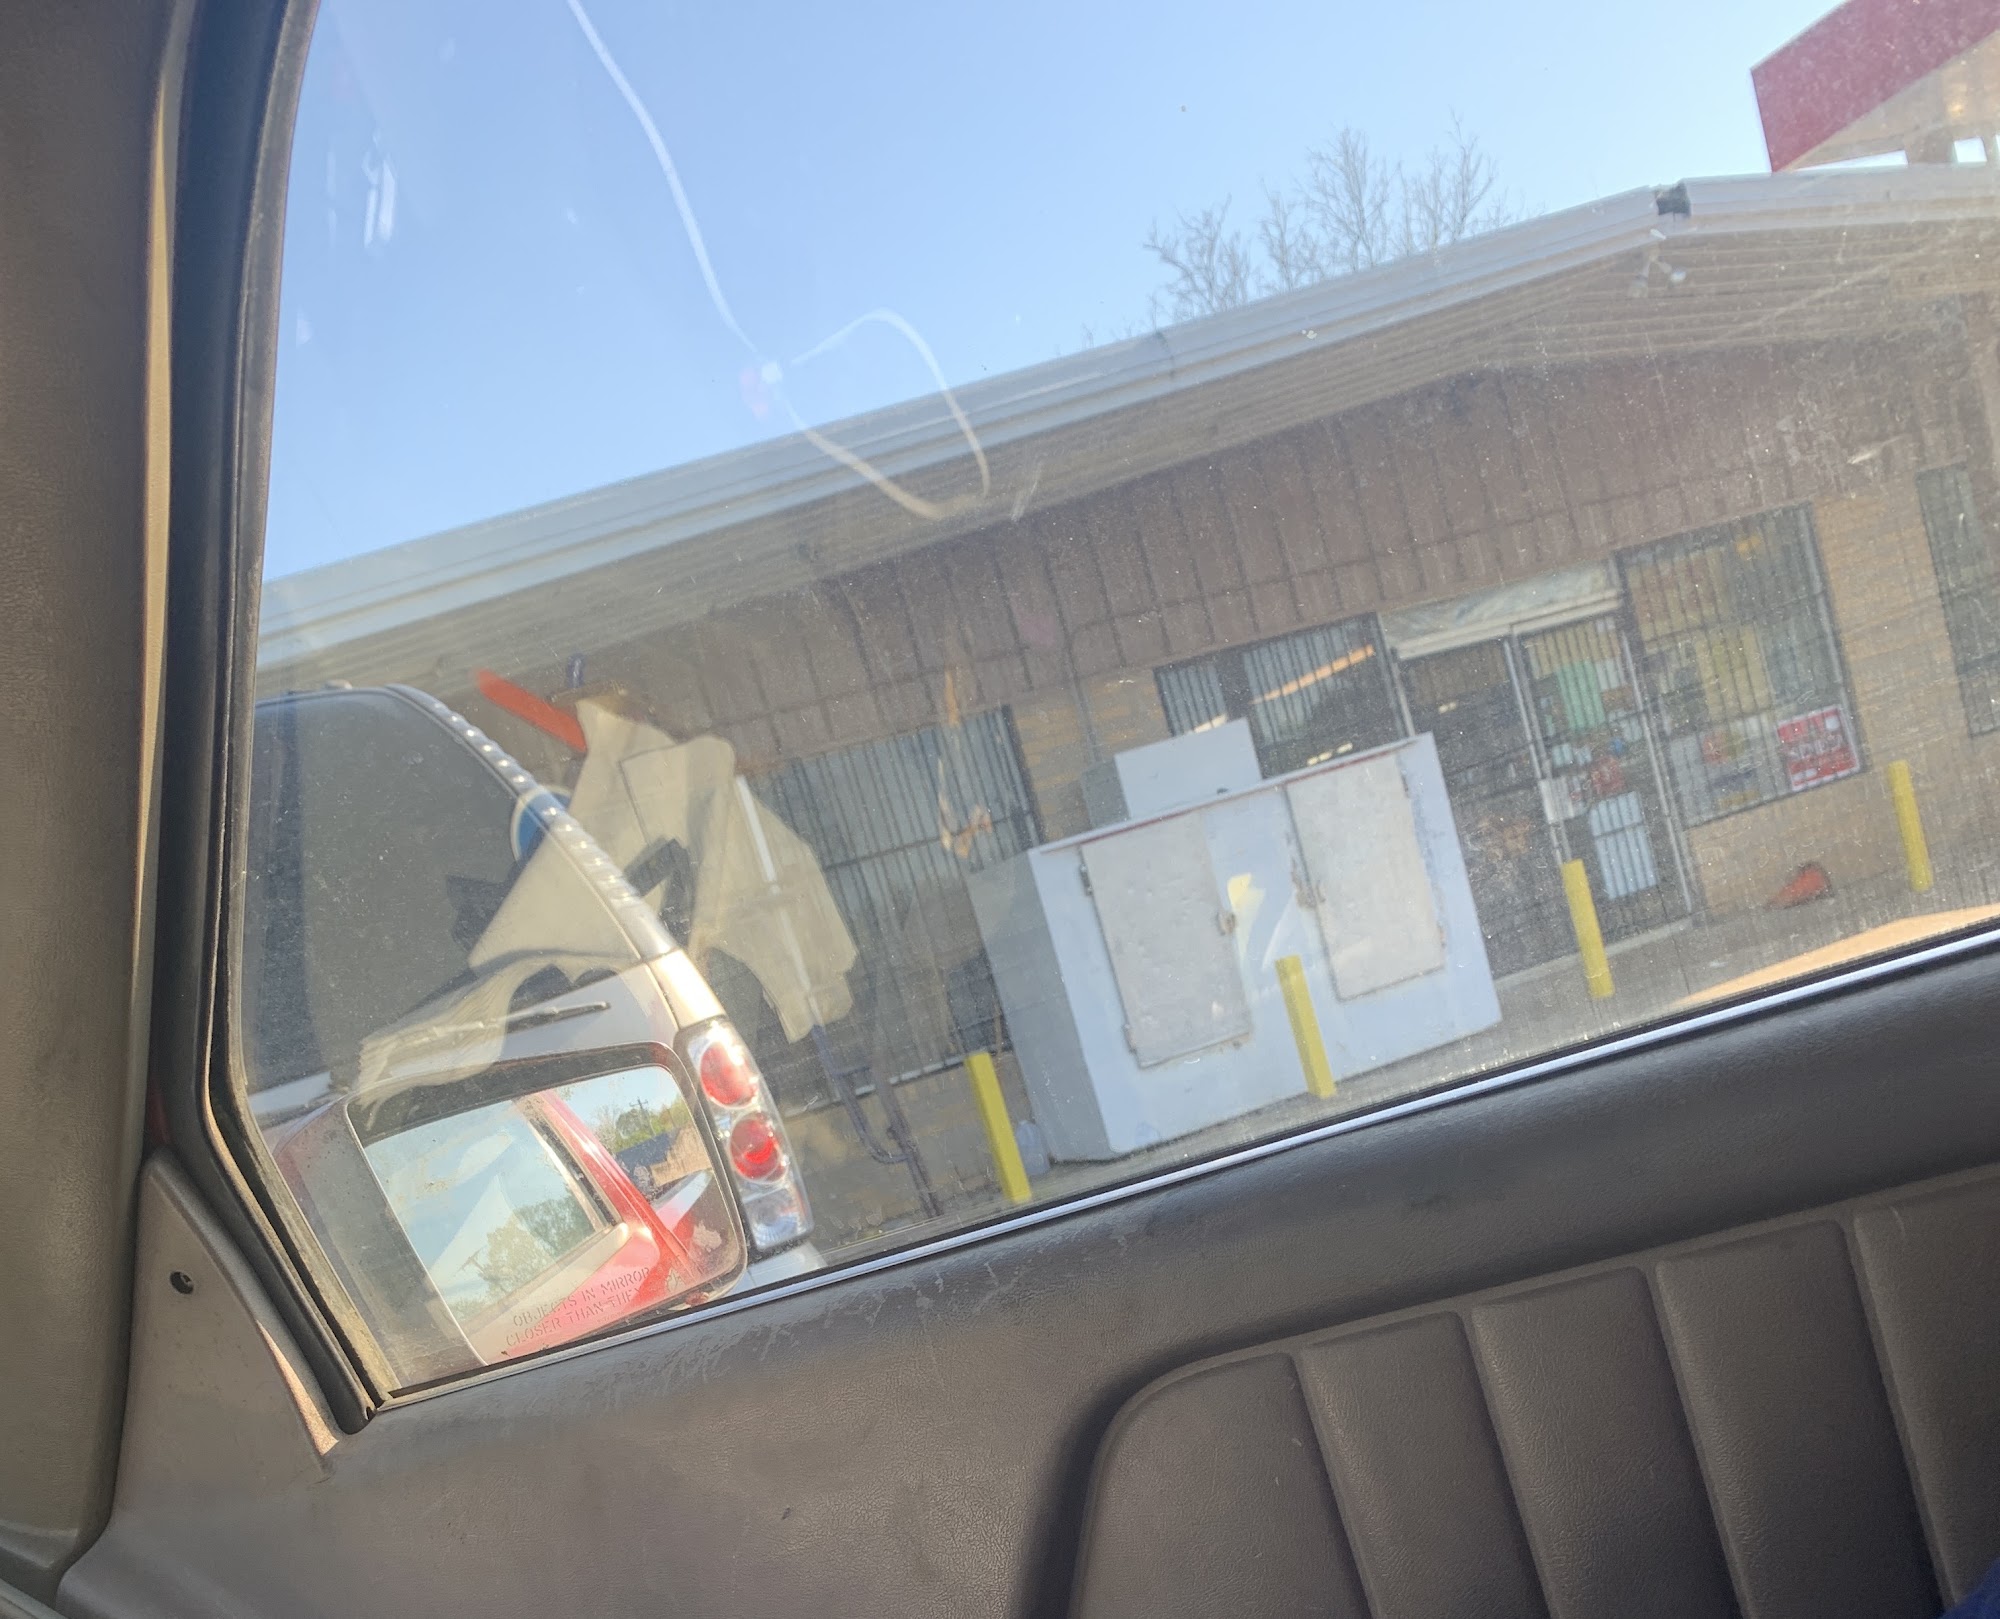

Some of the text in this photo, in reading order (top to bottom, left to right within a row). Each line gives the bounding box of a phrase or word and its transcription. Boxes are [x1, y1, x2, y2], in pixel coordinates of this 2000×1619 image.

[581, 1287, 596, 1301] IN
[600, 1267, 650, 1295] MIRROR
[506, 1317, 562, 1346] CLOSER
[565, 1301, 604, 1323] THAN
